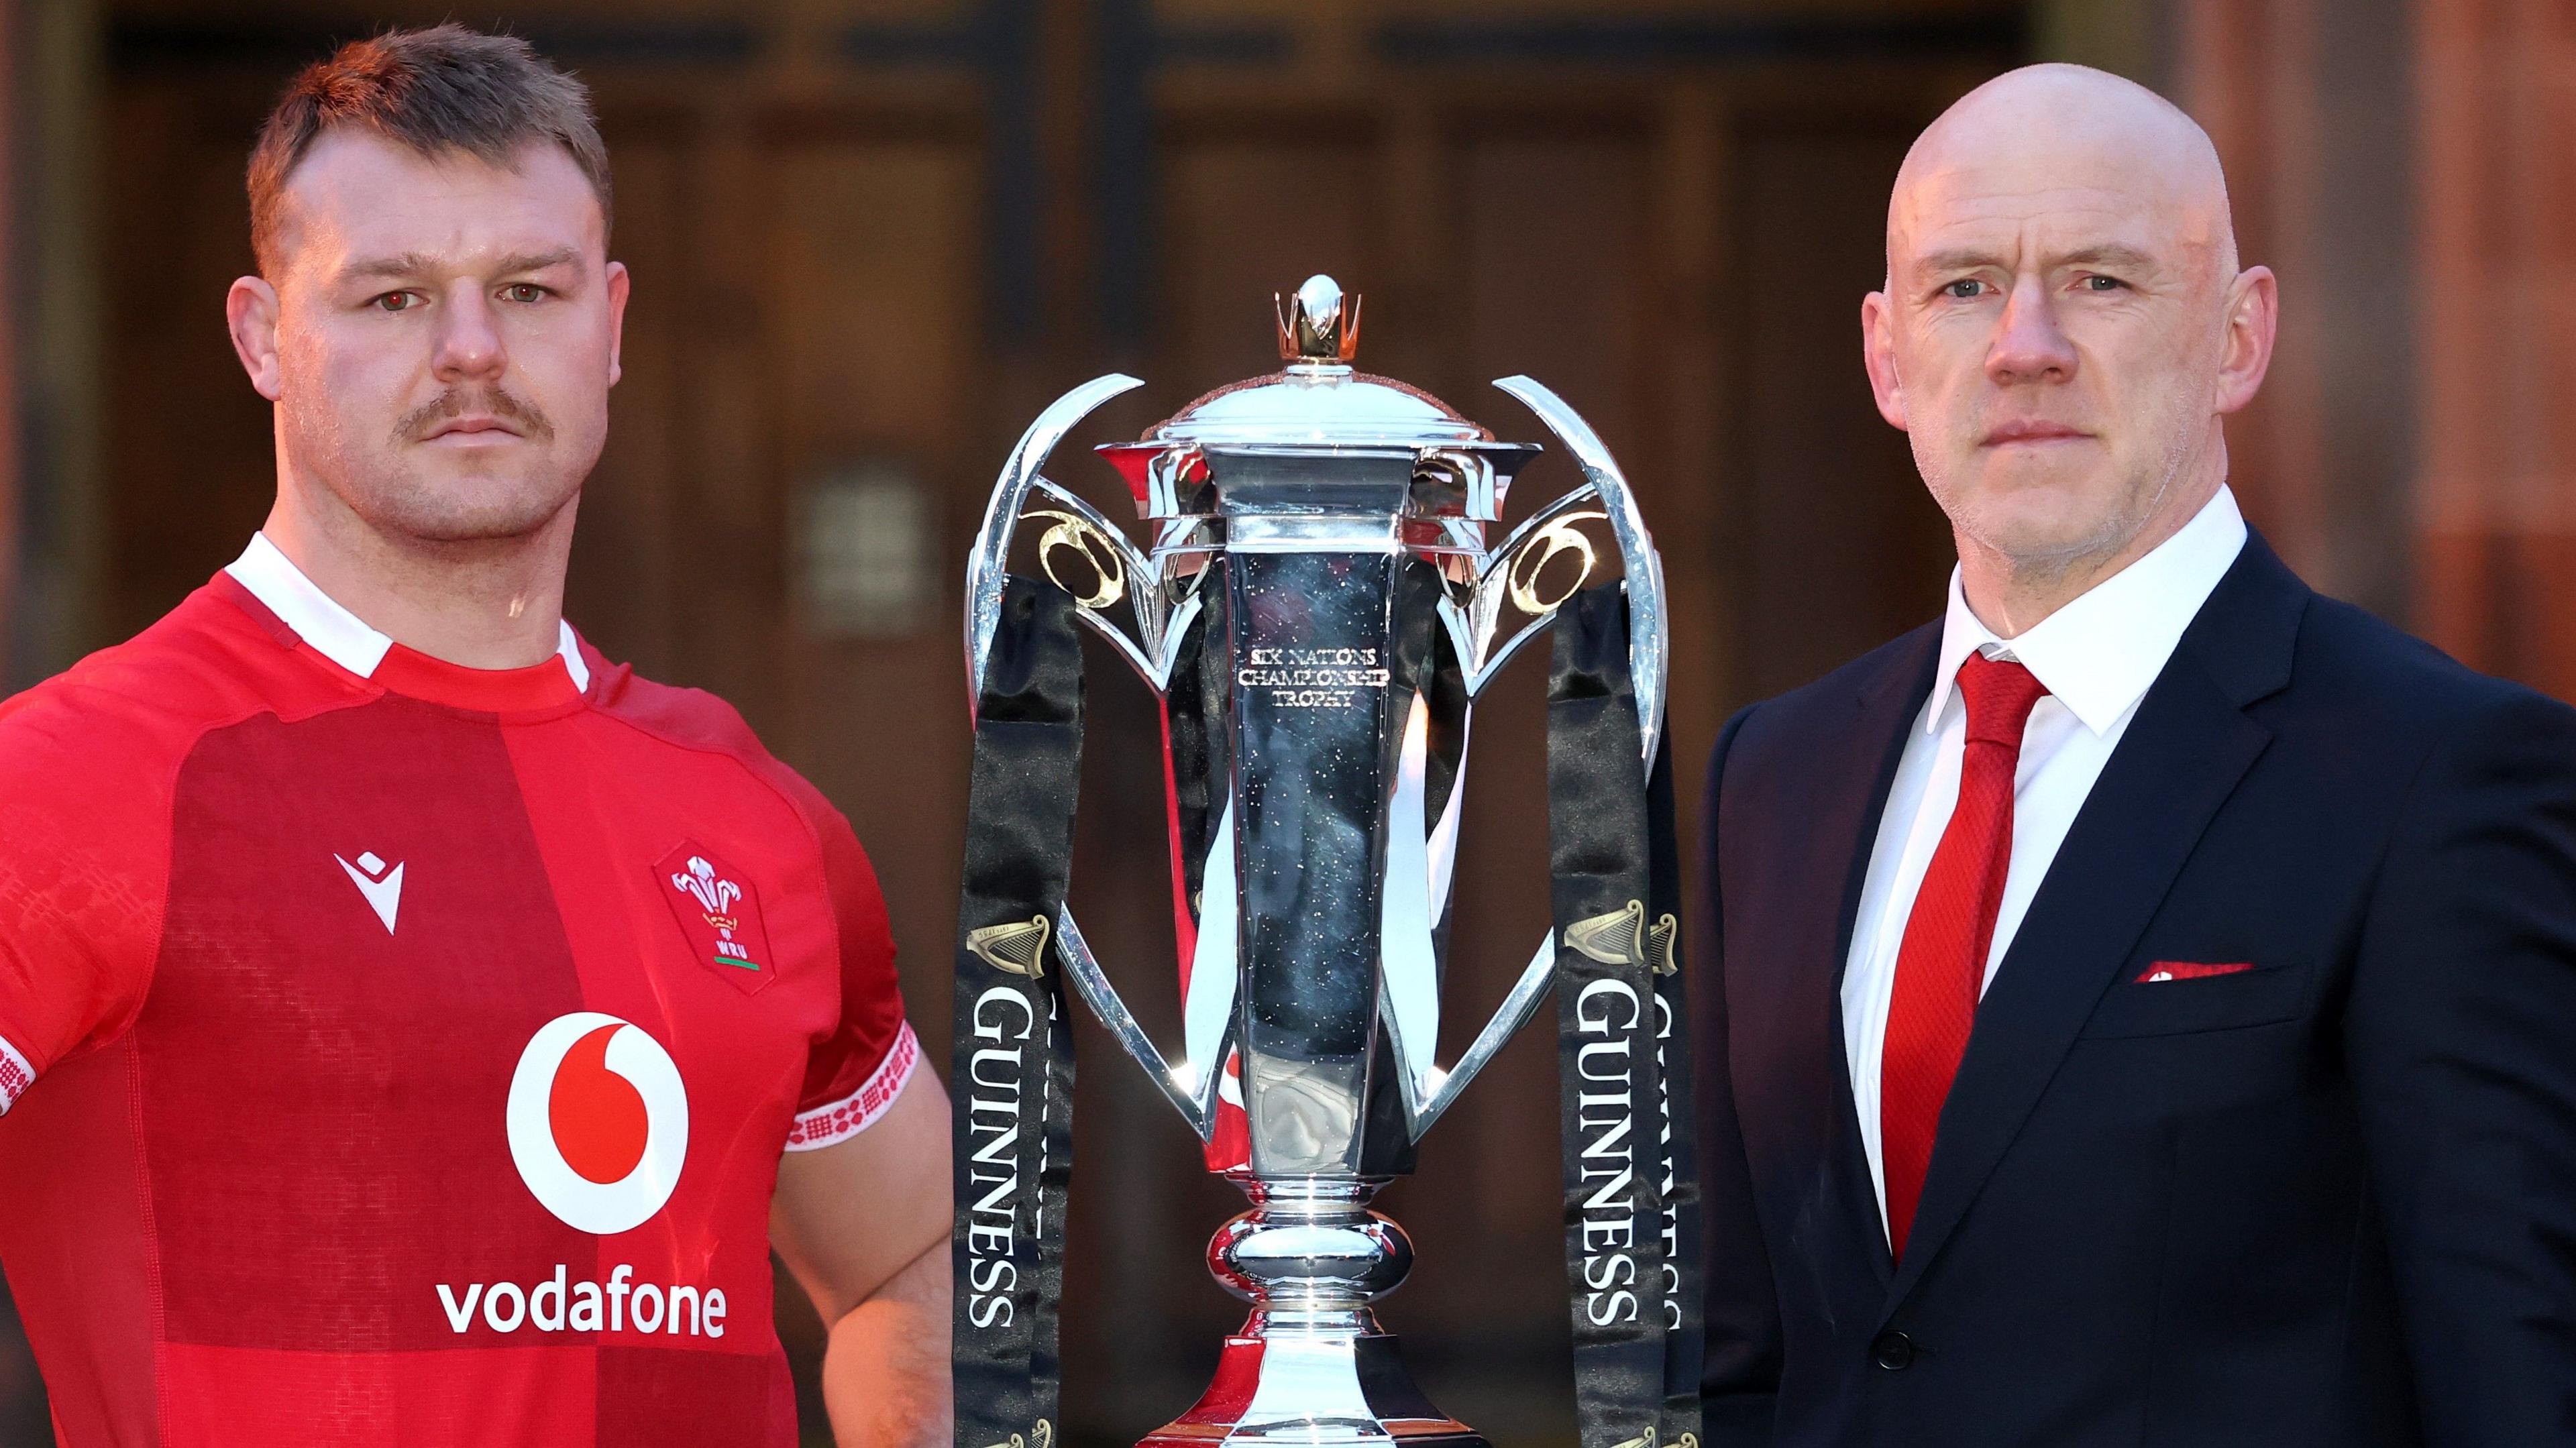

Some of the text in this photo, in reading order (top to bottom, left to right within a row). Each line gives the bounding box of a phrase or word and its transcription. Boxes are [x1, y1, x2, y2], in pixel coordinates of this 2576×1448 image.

[1250, 648, 1377, 665] SIX NATIONS
[1238, 669, 1391, 687] CHAMPIONSHIP
[1272, 689, 1355, 708] TROPHY
[715, 940, 748, 960] WRU
[967, 986, 1034, 1329] GUINNESS
[1576, 978, 1640, 1327] GUINNESS
[435, 1264, 727, 1339] vodafone
